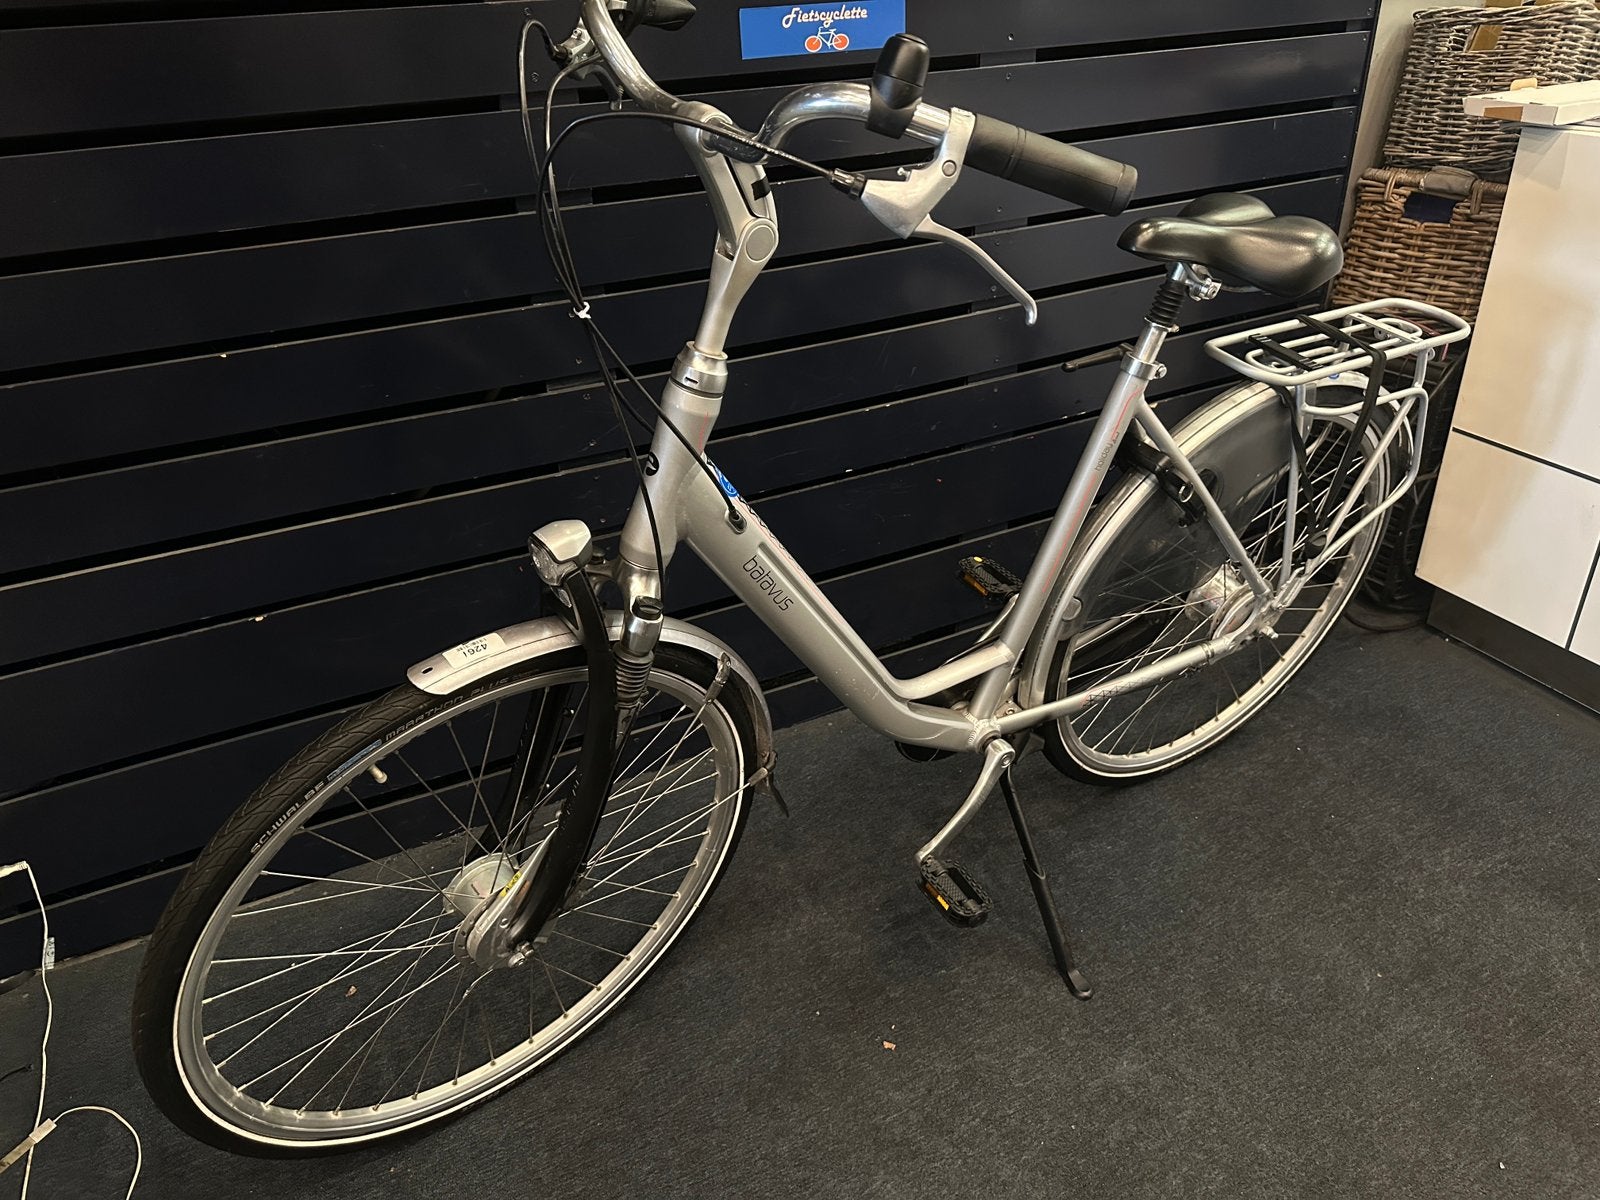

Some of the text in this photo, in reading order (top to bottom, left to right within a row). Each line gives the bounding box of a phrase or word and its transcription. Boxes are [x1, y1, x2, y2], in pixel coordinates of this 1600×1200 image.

[782, 5, 868, 28] Fietscyclette
[743, 555, 794, 611] batavus
[250, 781, 324, 853] SCHWALBE
